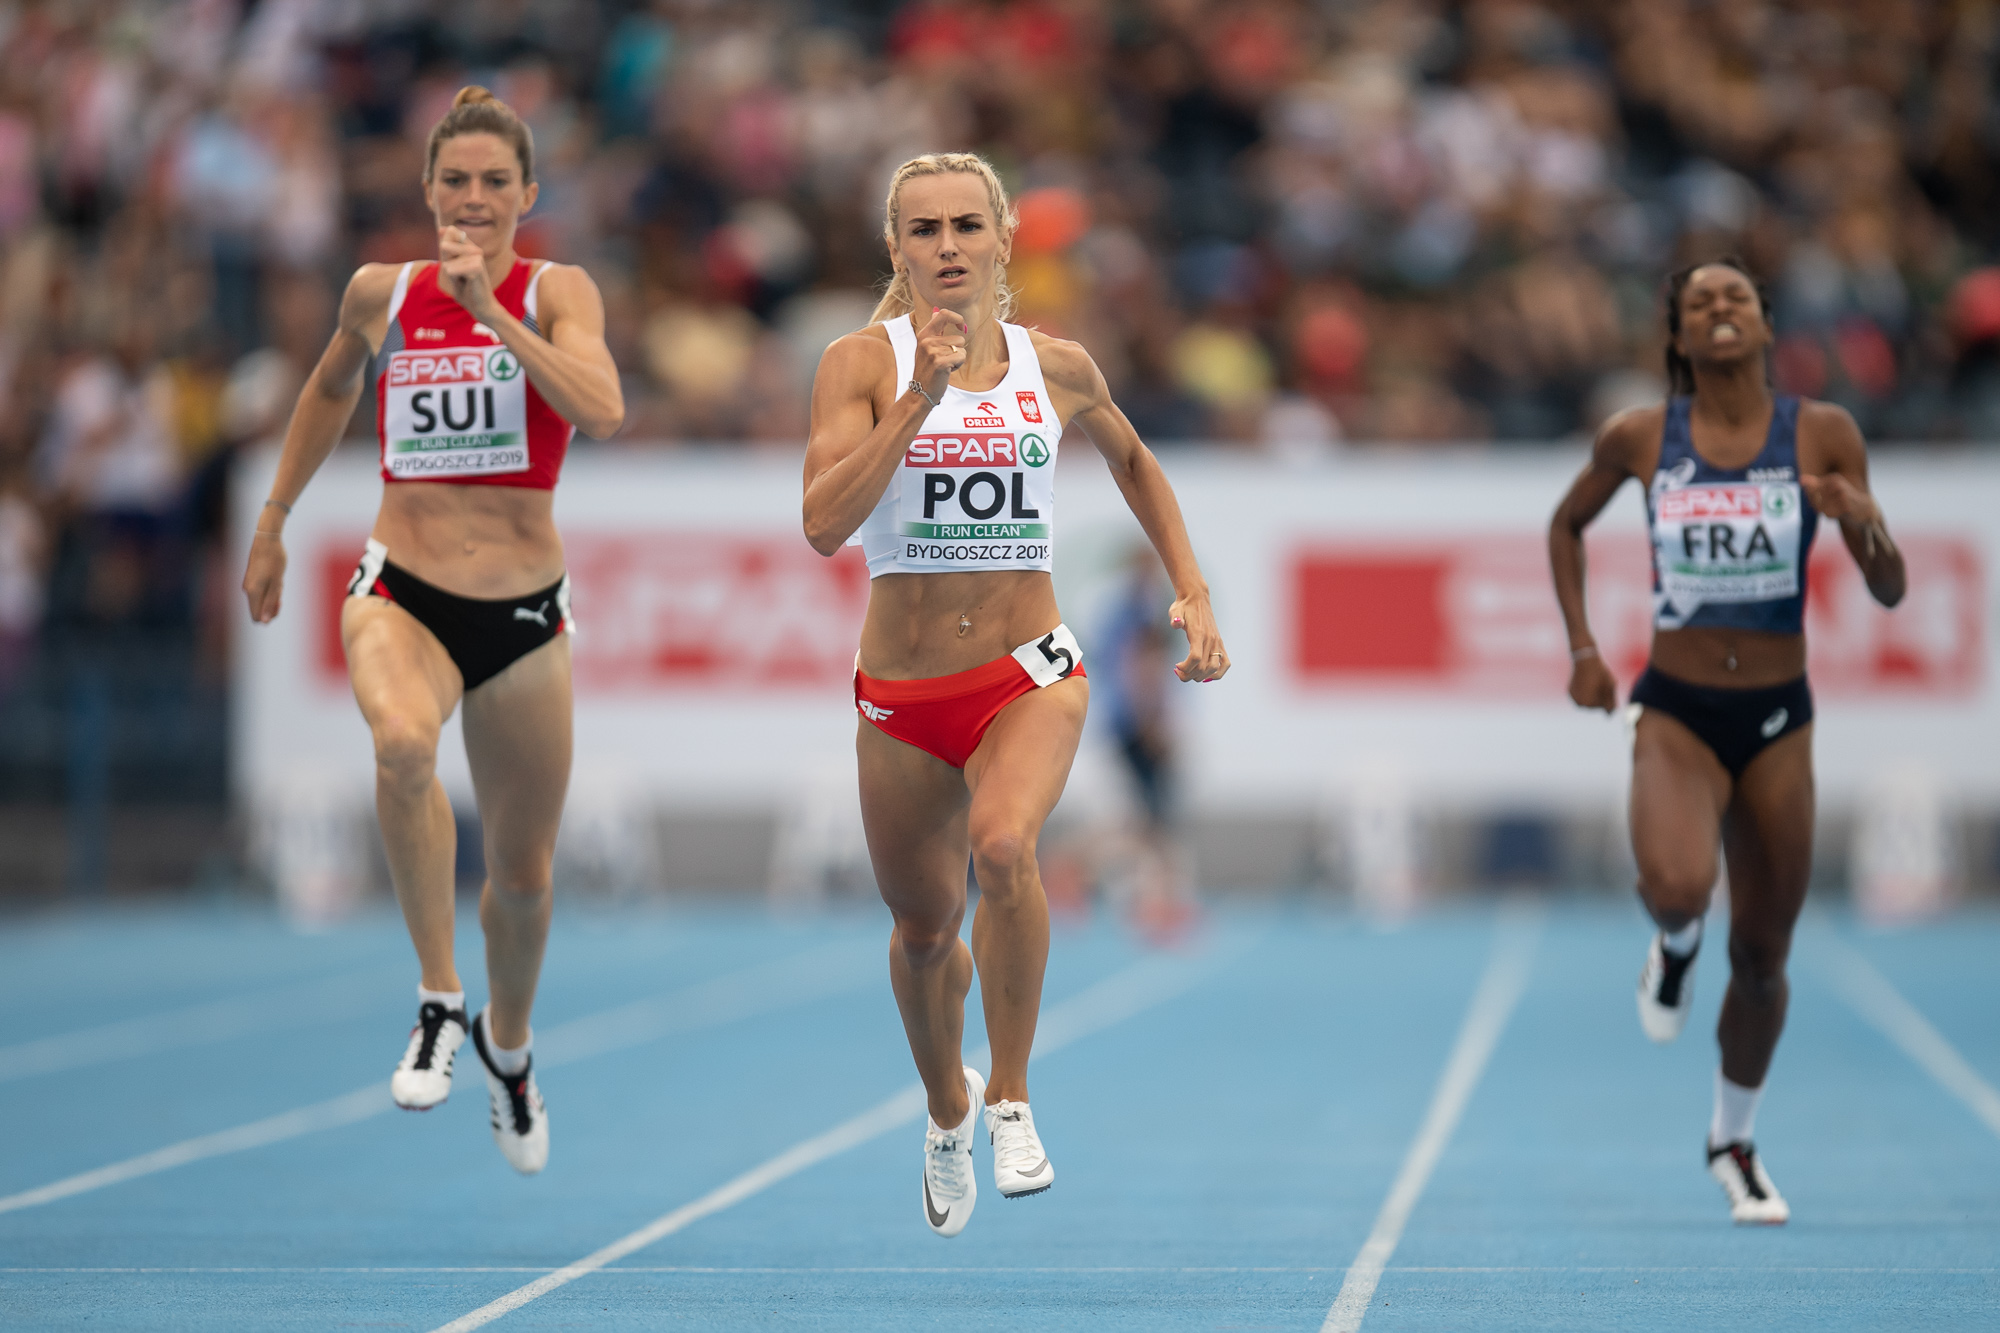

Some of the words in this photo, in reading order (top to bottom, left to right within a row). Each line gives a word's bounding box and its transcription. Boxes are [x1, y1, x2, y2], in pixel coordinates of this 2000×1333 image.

[391, 355, 484, 384] SPAR
[410, 387, 496, 434] SUI
[966, 418, 1003, 428] ORLEN
[421, 438, 448, 450] RUN
[450, 434, 492, 448] CLEAN
[908, 437, 1014, 463] SPAR
[393, 453, 484, 471] BYDGOSZCZ
[489, 450, 524, 466] 2019
[923, 471, 1040, 521] POL
[1664, 488, 1760, 517] SPAR
[933, 525, 937, 537] I
[941, 525, 971, 537] RUN
[1682, 523, 1776, 561] FRA
[906, 543, 1012, 560] BYDGOSZCZ
[1036, 632, 1074, 678] 5
